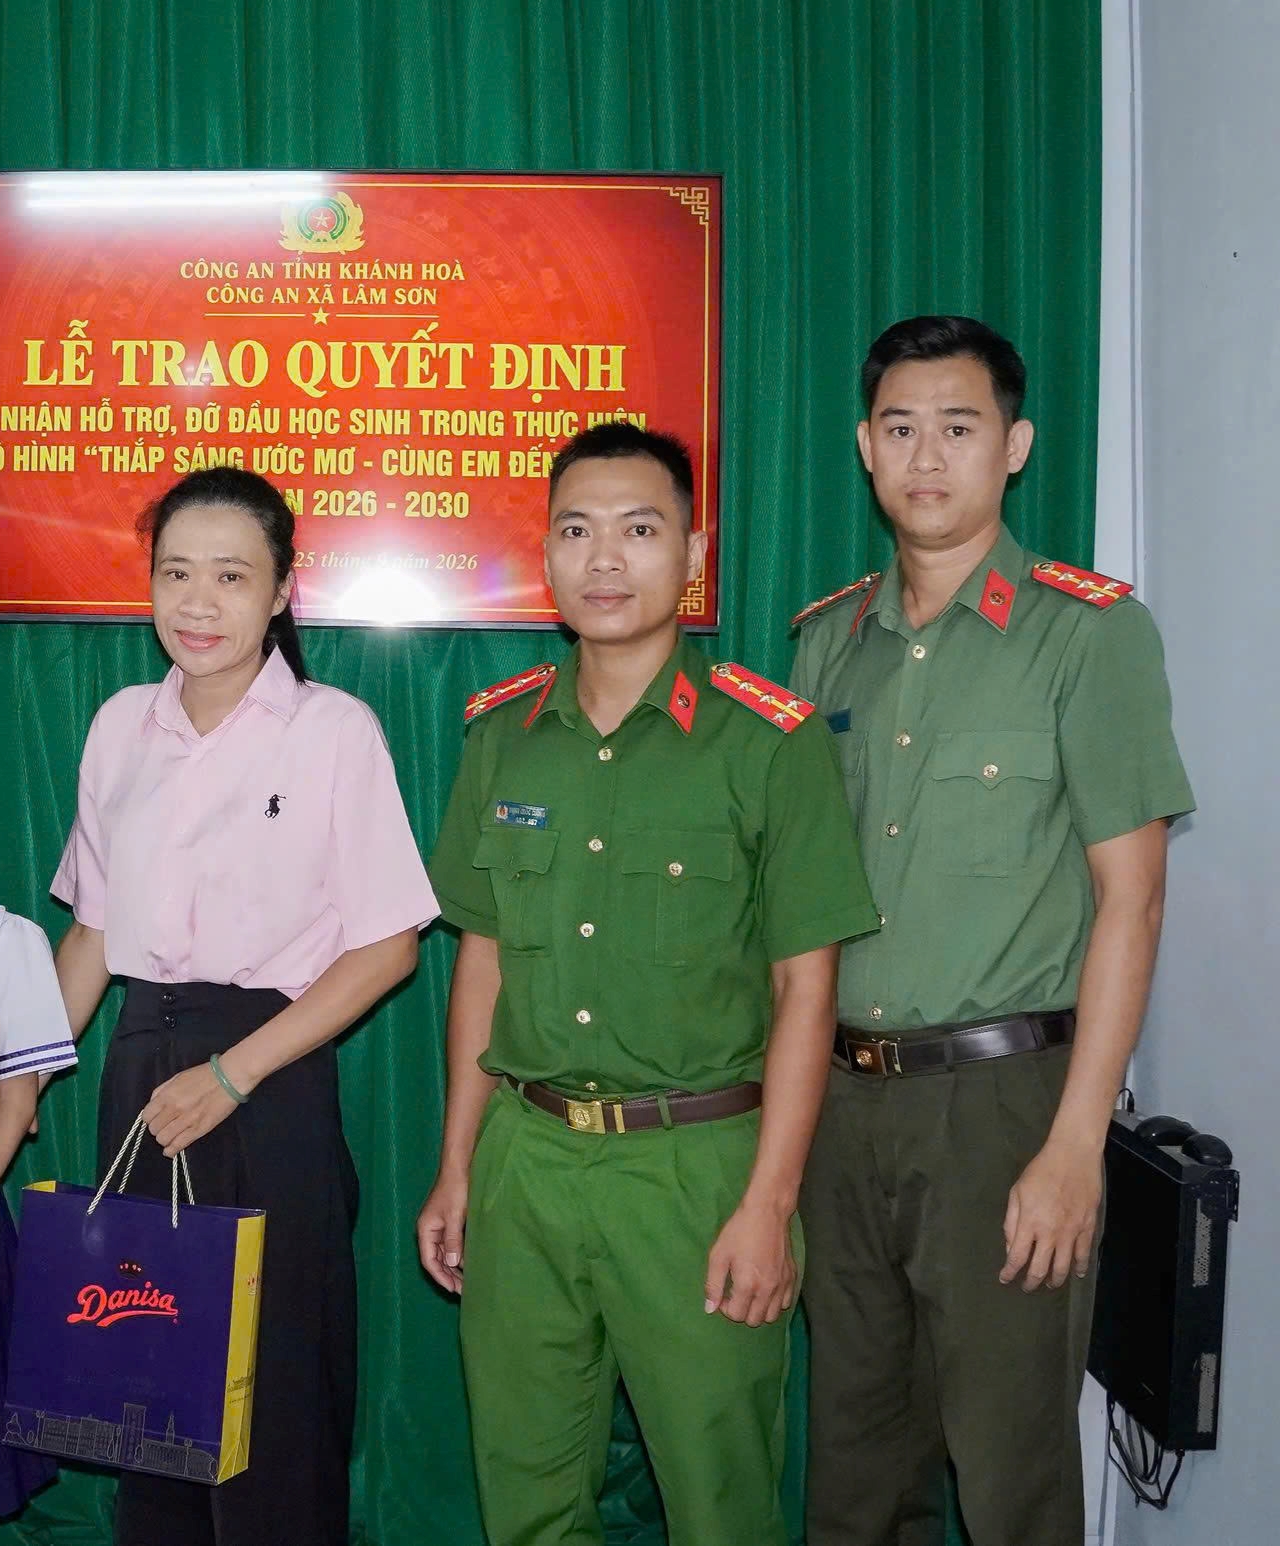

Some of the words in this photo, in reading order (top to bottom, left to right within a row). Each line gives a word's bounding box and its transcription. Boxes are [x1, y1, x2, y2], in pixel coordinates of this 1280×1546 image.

[180, 258, 239, 279] CÔNG
[246, 262, 274, 279] AN
[282, 256, 331, 279] TỈNH
[339, 259, 413, 280] KHÁNH
[421, 260, 465, 281] HOÀ
[206, 283, 264, 304] CÔNG
[271, 287, 300, 304] AN
[307, 284, 335, 304] XÃ
[342, 284, 387, 305] LÂM
[394, 286, 437, 305] SƠN
[23, 319, 94, 386] LỄ
[112, 339, 270, 387] TRAO
[286, 322, 474, 398] QUYẾT
[489, 343, 626, 404] ĐỊNH
[1, 401, 72, 437] NHẬN
[80, 398, 113, 432] HỖ
[122, 404, 177, 438] TRỢ,
[186, 402, 221, 433] ĐỠ
[228, 400, 280, 434] ĐẦU
[289, 408, 340, 440] HỌC
[349, 408, 410, 435] SINH
[419, 410, 504, 437] TRONG
[513, 410, 578, 442] THỰC
[13, 440, 75, 472] HÌNH
[84, 437, 165, 473] “THẮP
[173, 442, 243, 474] SÁNG
[252, 441, 305, 475] ƯỚC
[314, 446, 356, 475] MƠ
[382, 444, 452, 476] CÙNG
[462, 451, 500, 477] EM
[313, 489, 377, 517] 2026
[405, 491, 469, 518] 2030
[295, 552, 314, 569] 25
[435, 553, 478, 571] 2026
[66, 1281, 178, 1327] Danisa
